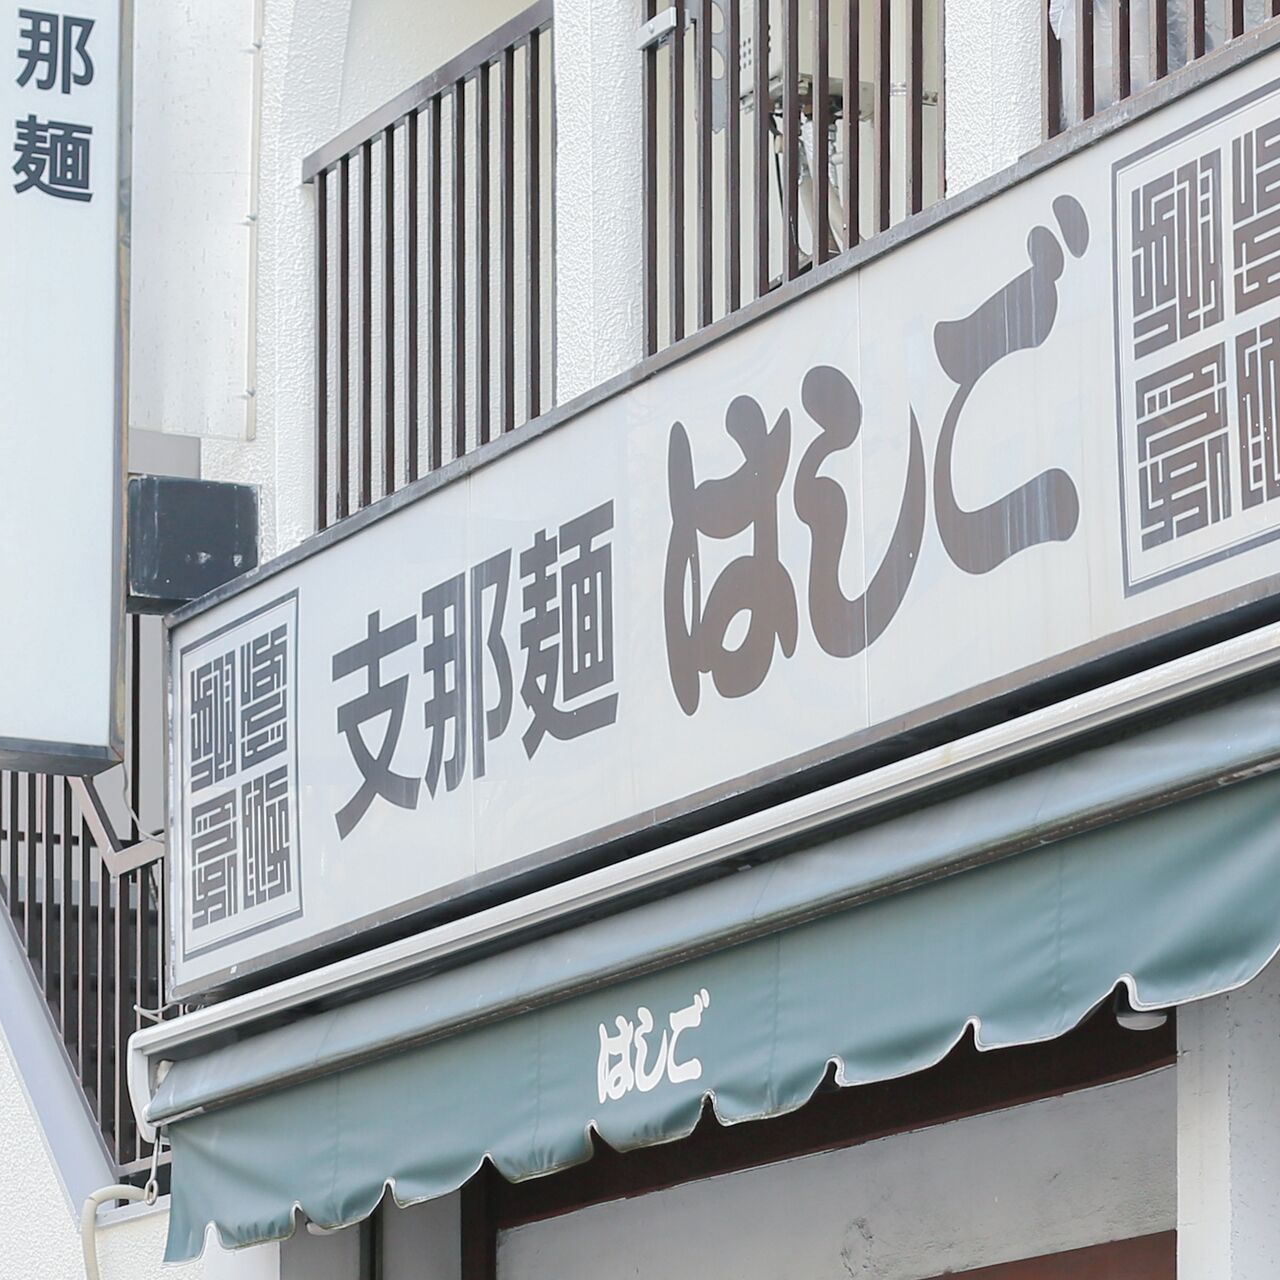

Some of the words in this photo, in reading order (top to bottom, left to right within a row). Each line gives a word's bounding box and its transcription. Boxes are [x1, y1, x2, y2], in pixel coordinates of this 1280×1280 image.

[13, 8, 96, 203] 那麺
[331, 498, 619, 840] 支那麺
[664, 193, 1090, 718] はしご
[597, 988, 711, 1104] はしご
